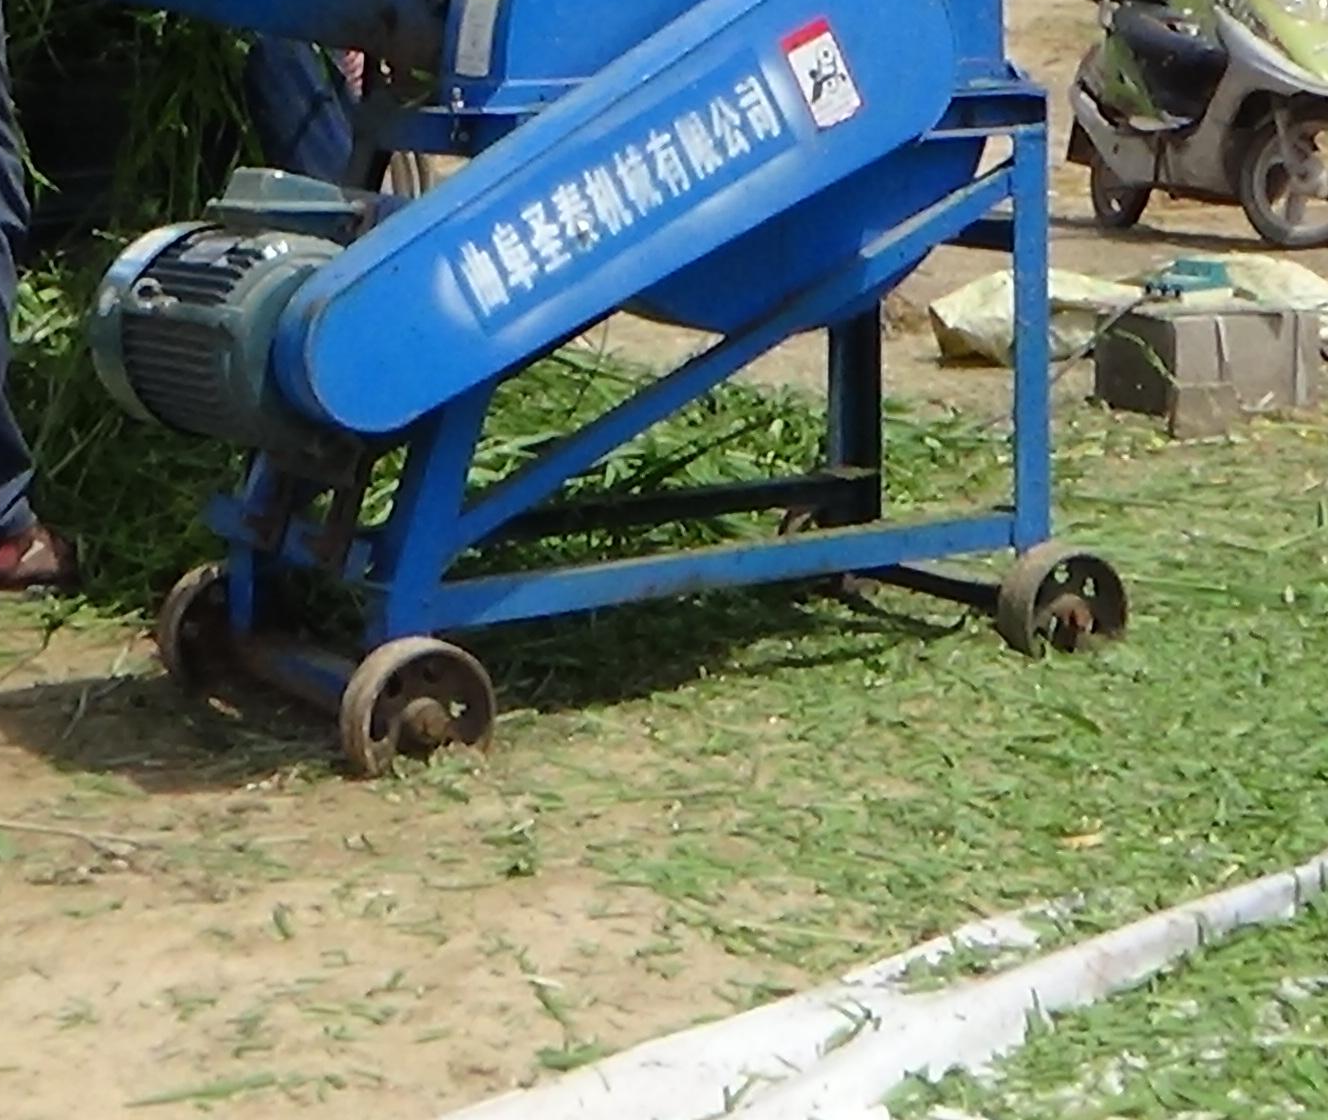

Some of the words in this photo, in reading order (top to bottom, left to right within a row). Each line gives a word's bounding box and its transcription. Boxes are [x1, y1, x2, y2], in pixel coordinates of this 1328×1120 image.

[459, 75, 781, 317] 曲阜圣泰机械有限公司
